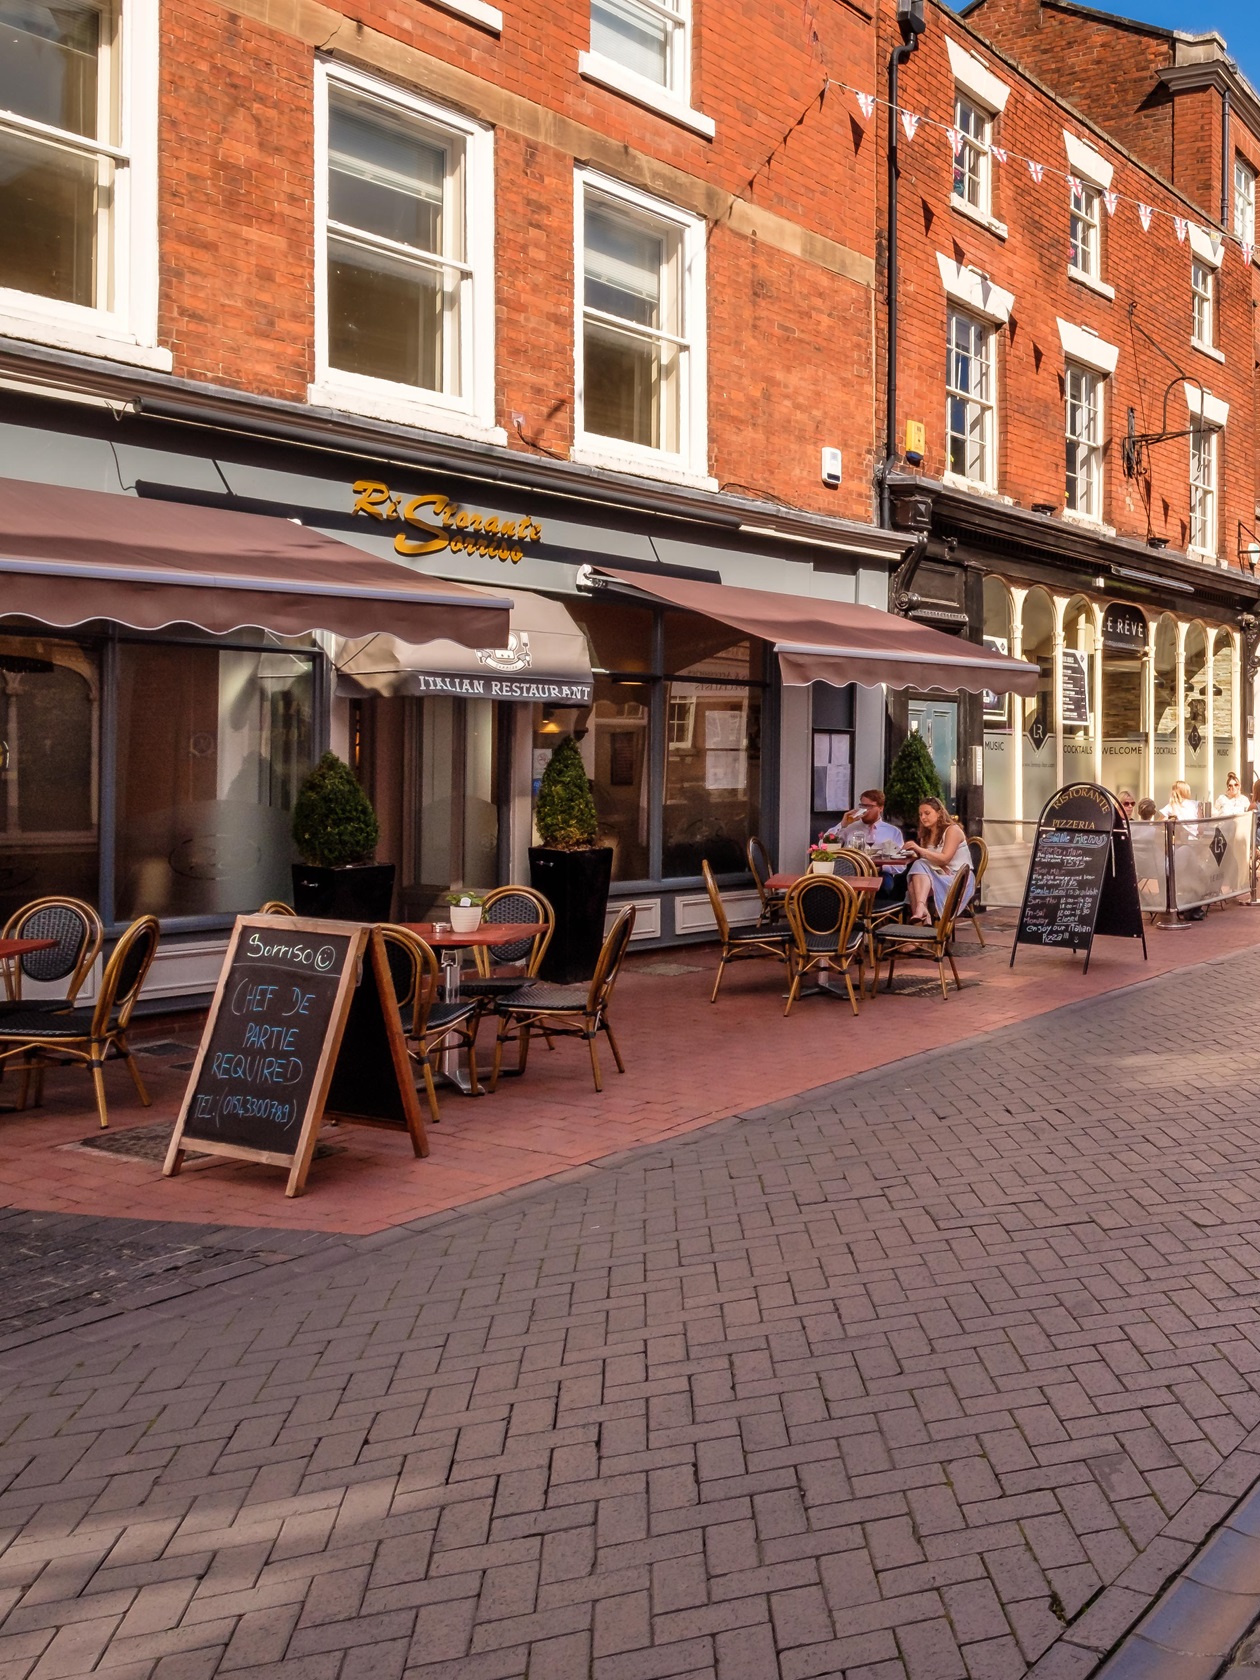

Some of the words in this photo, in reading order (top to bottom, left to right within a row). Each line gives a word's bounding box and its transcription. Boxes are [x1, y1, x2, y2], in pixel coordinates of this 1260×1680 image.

[1117, 613, 1144, 637] RÊVE
[418, 675, 485, 694] ITALIAN
[491, 681, 591, 701] RESTAURANT
[984, 740, 1005, 752] MUSIC
[1063, 744, 1093, 755] COCKTAILS
[1101, 746, 1142, 755] WELCOME
[1216, 748, 1229, 757] MUSIC
[1053, 787, 1110, 815] RISTORANTE
[1052, 819, 1095, 830] PIZZERIA
[246, 933, 313, 966] Sorriso
[230, 977, 278, 1017] CHEF
[282, 986, 316, 1017] DE
[242, 1021, 299, 1052] PARTIE
[211, 1052, 304, 1085] REQUIRED
